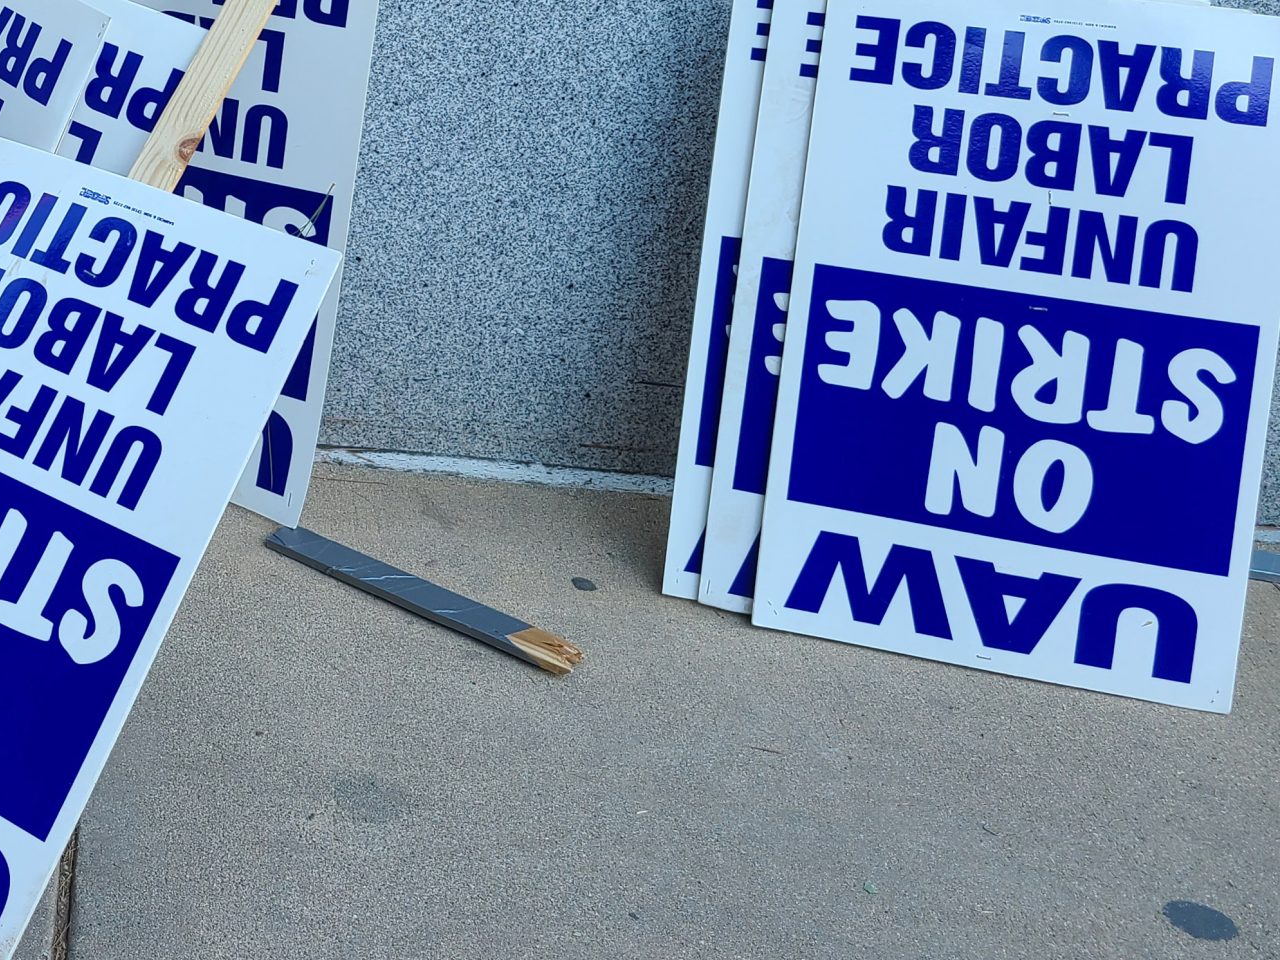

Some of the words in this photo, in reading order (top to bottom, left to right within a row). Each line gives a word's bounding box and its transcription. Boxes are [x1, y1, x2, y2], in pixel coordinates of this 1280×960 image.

[849, 15, 1275, 127] PRACTICE
[909, 104, 1194, 205] LABOR
[882, 185, 1200, 293] UNFAIR
[817, 298, 1237, 445] STRIKE
[924, 425, 1095, 535] ON
[784, 530, 1199, 684] UAW
